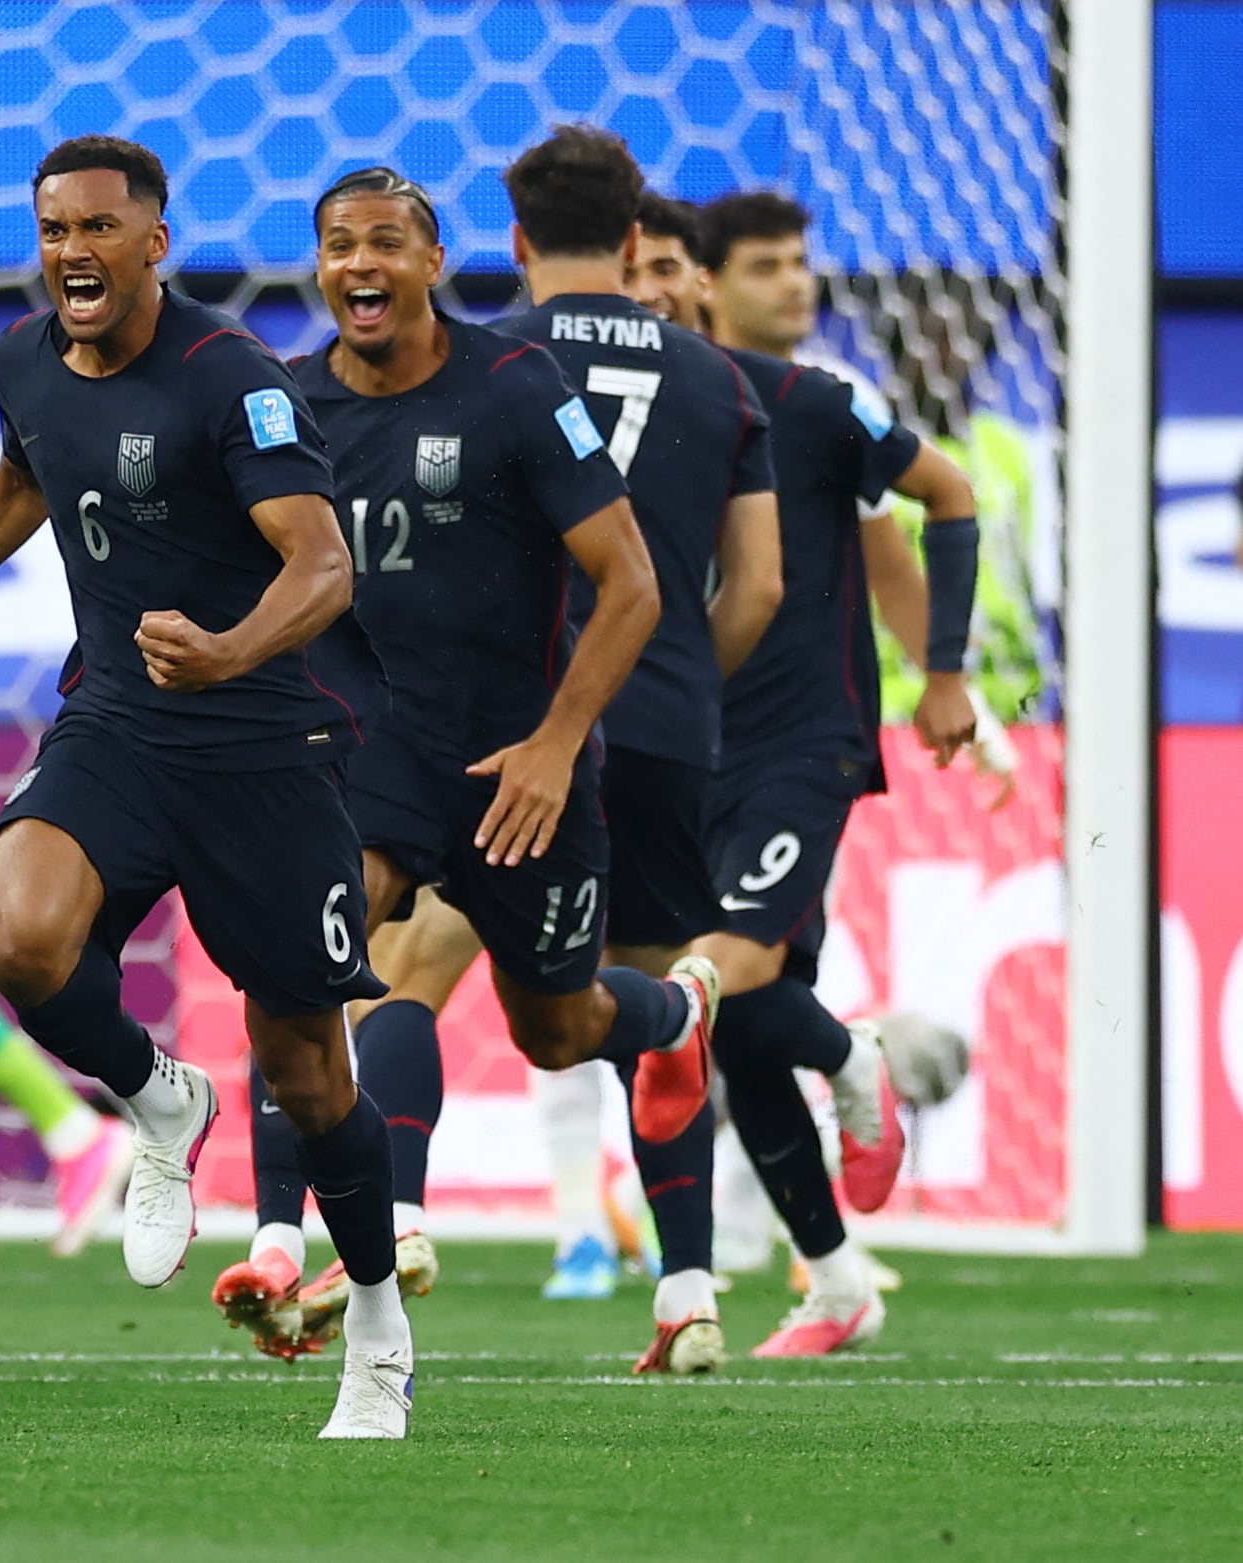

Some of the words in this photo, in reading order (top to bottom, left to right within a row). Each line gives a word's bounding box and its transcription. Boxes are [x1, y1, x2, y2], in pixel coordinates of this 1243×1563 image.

[551, 314, 663, 352] REYNA
[121, 437, 151, 463] USA
[419, 440, 457, 465] USA
[586, 364, 662, 478] 7
[78, 490, 110, 562] 6
[351, 498, 413, 575] 12
[738, 830, 802, 892] 9
[322, 882, 351, 964] 6
[534, 877, 598, 952] 12
